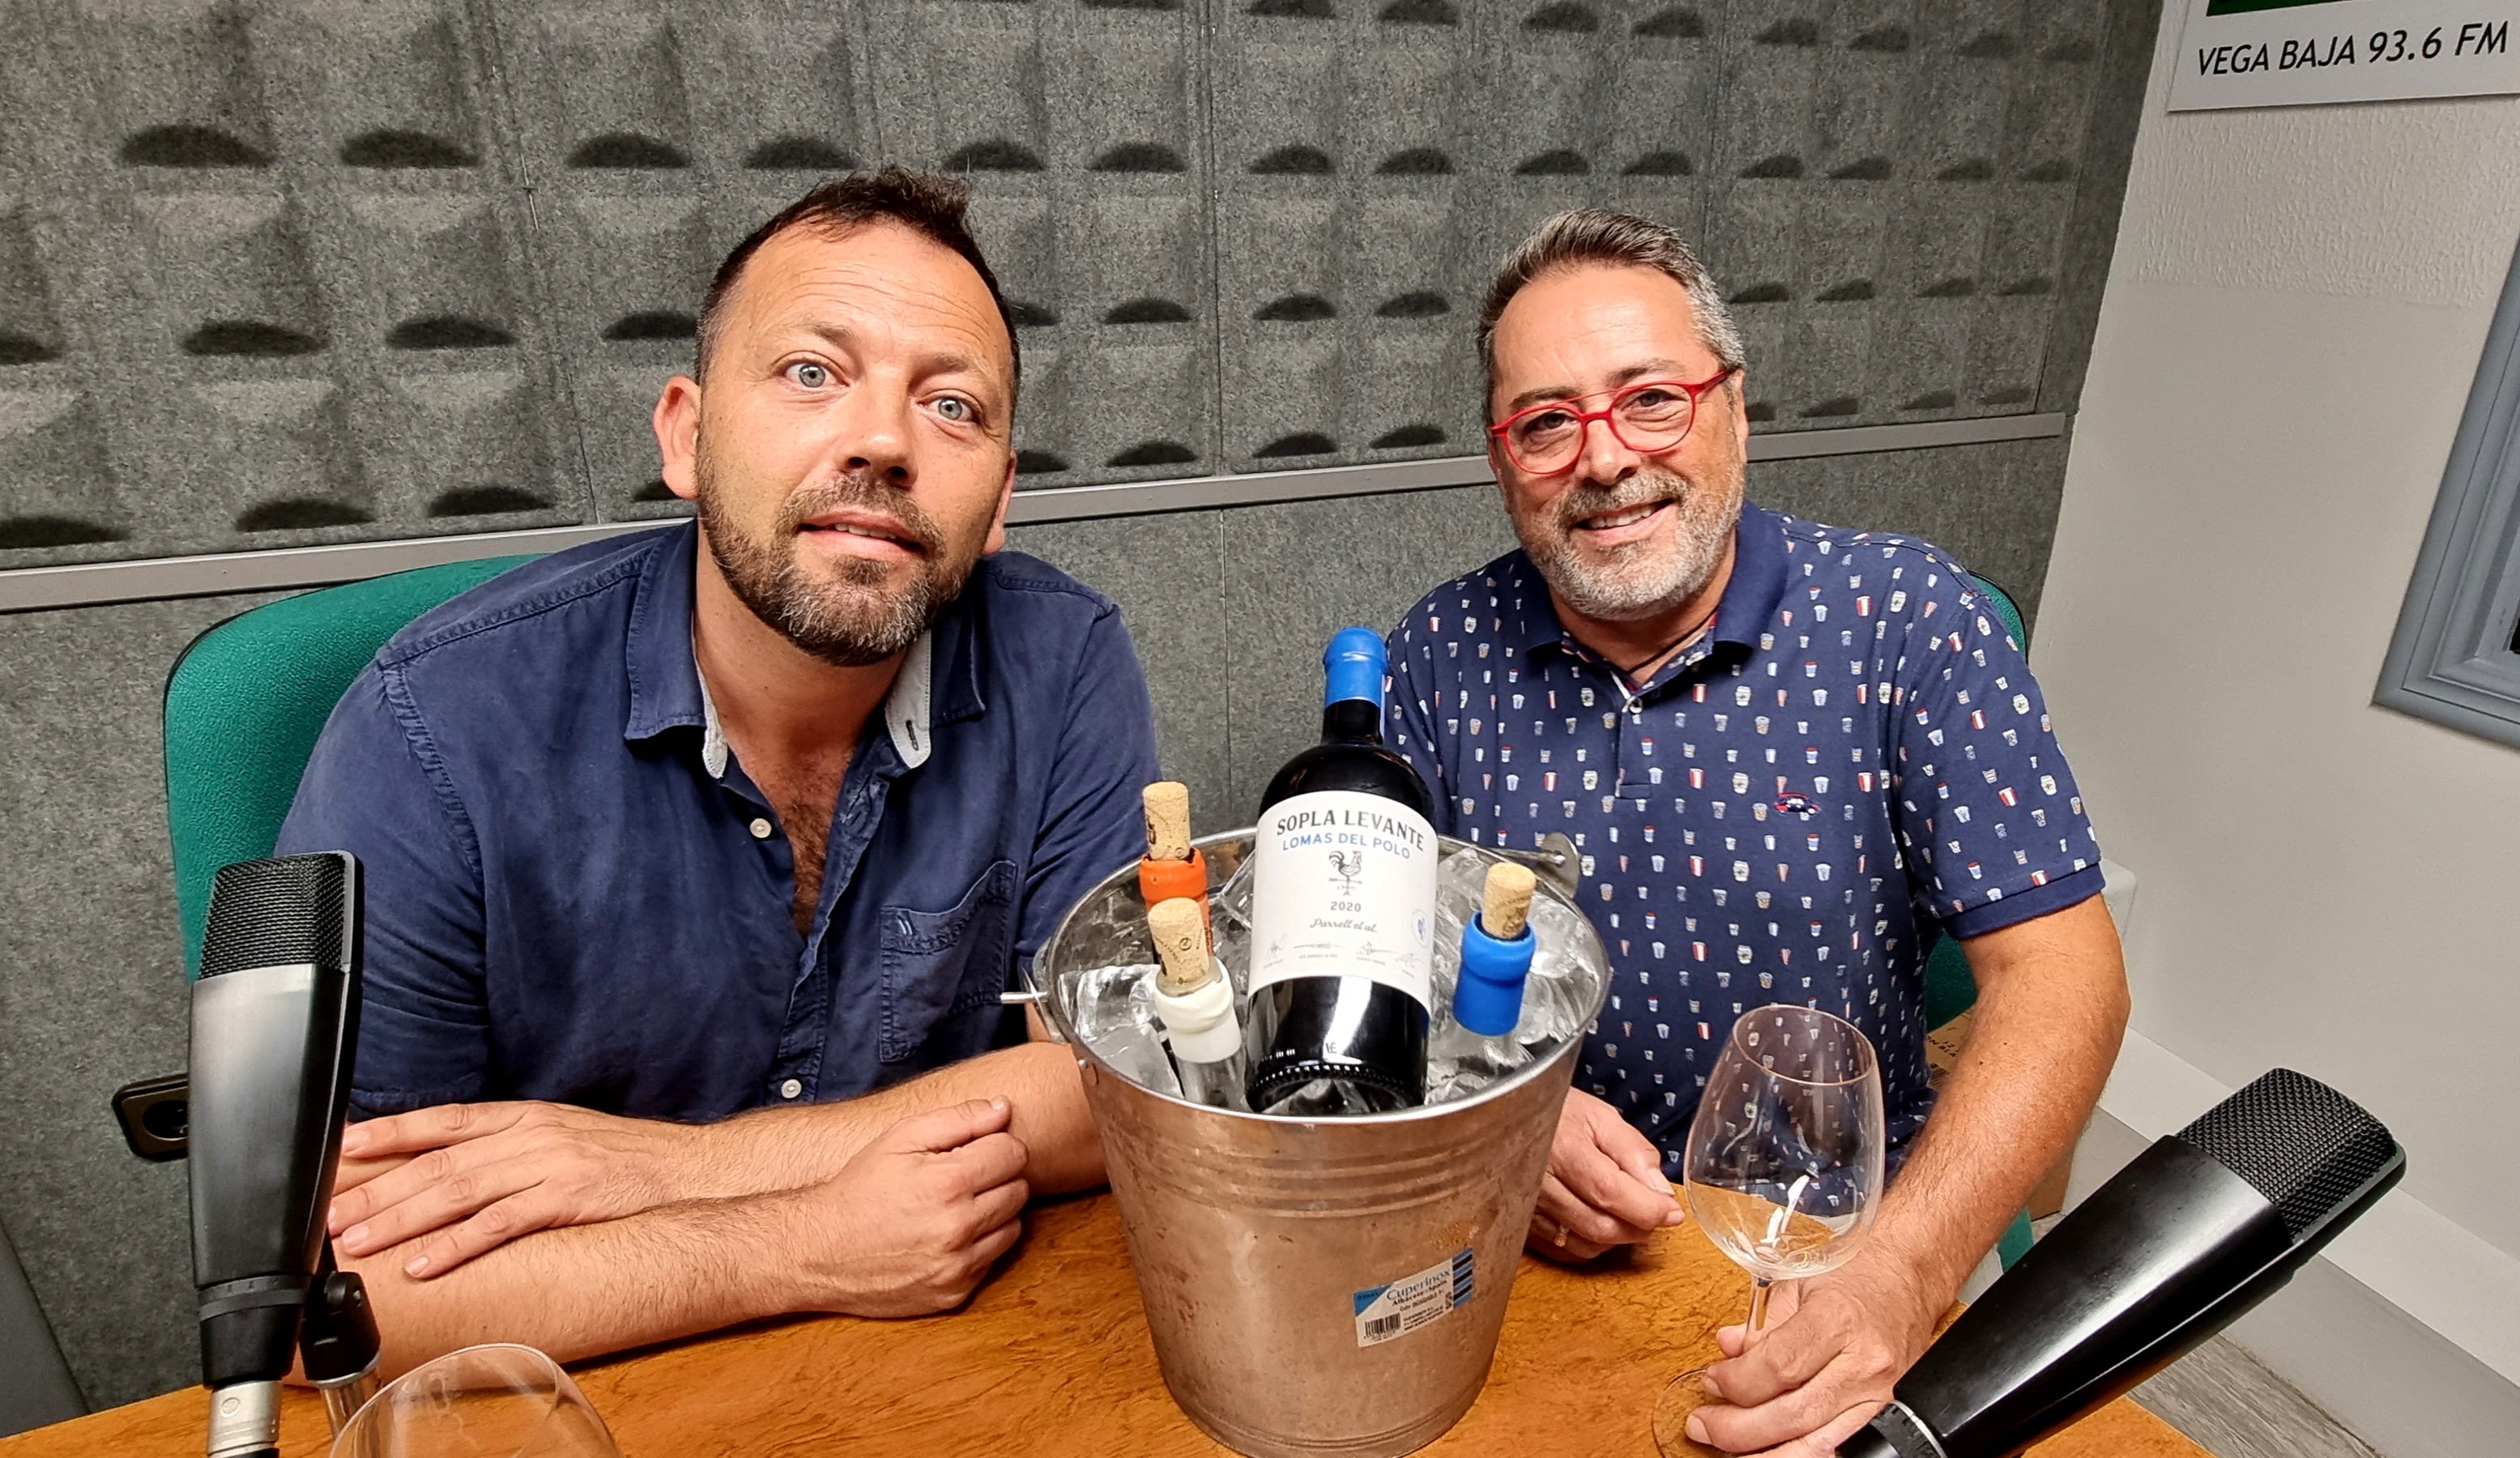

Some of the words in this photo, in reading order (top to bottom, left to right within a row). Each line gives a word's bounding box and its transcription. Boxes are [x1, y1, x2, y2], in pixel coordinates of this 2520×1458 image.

[2198, 43, 2269, 75] VEGA
[2279, 35, 2356, 70] BAJA
[2369, 27, 2442, 63] 93.6
[2454, 20, 2509, 56] FM
[1276, 809, 1337, 836] SOPLA
[1344, 809, 1424, 851] LEVANTE
[1282, 832, 1333, 851] LOMAS
[1337, 832, 1367, 846] DEL
[1372, 837, 1411, 859] POLO
[1330, 901, 1362, 912] 2020
